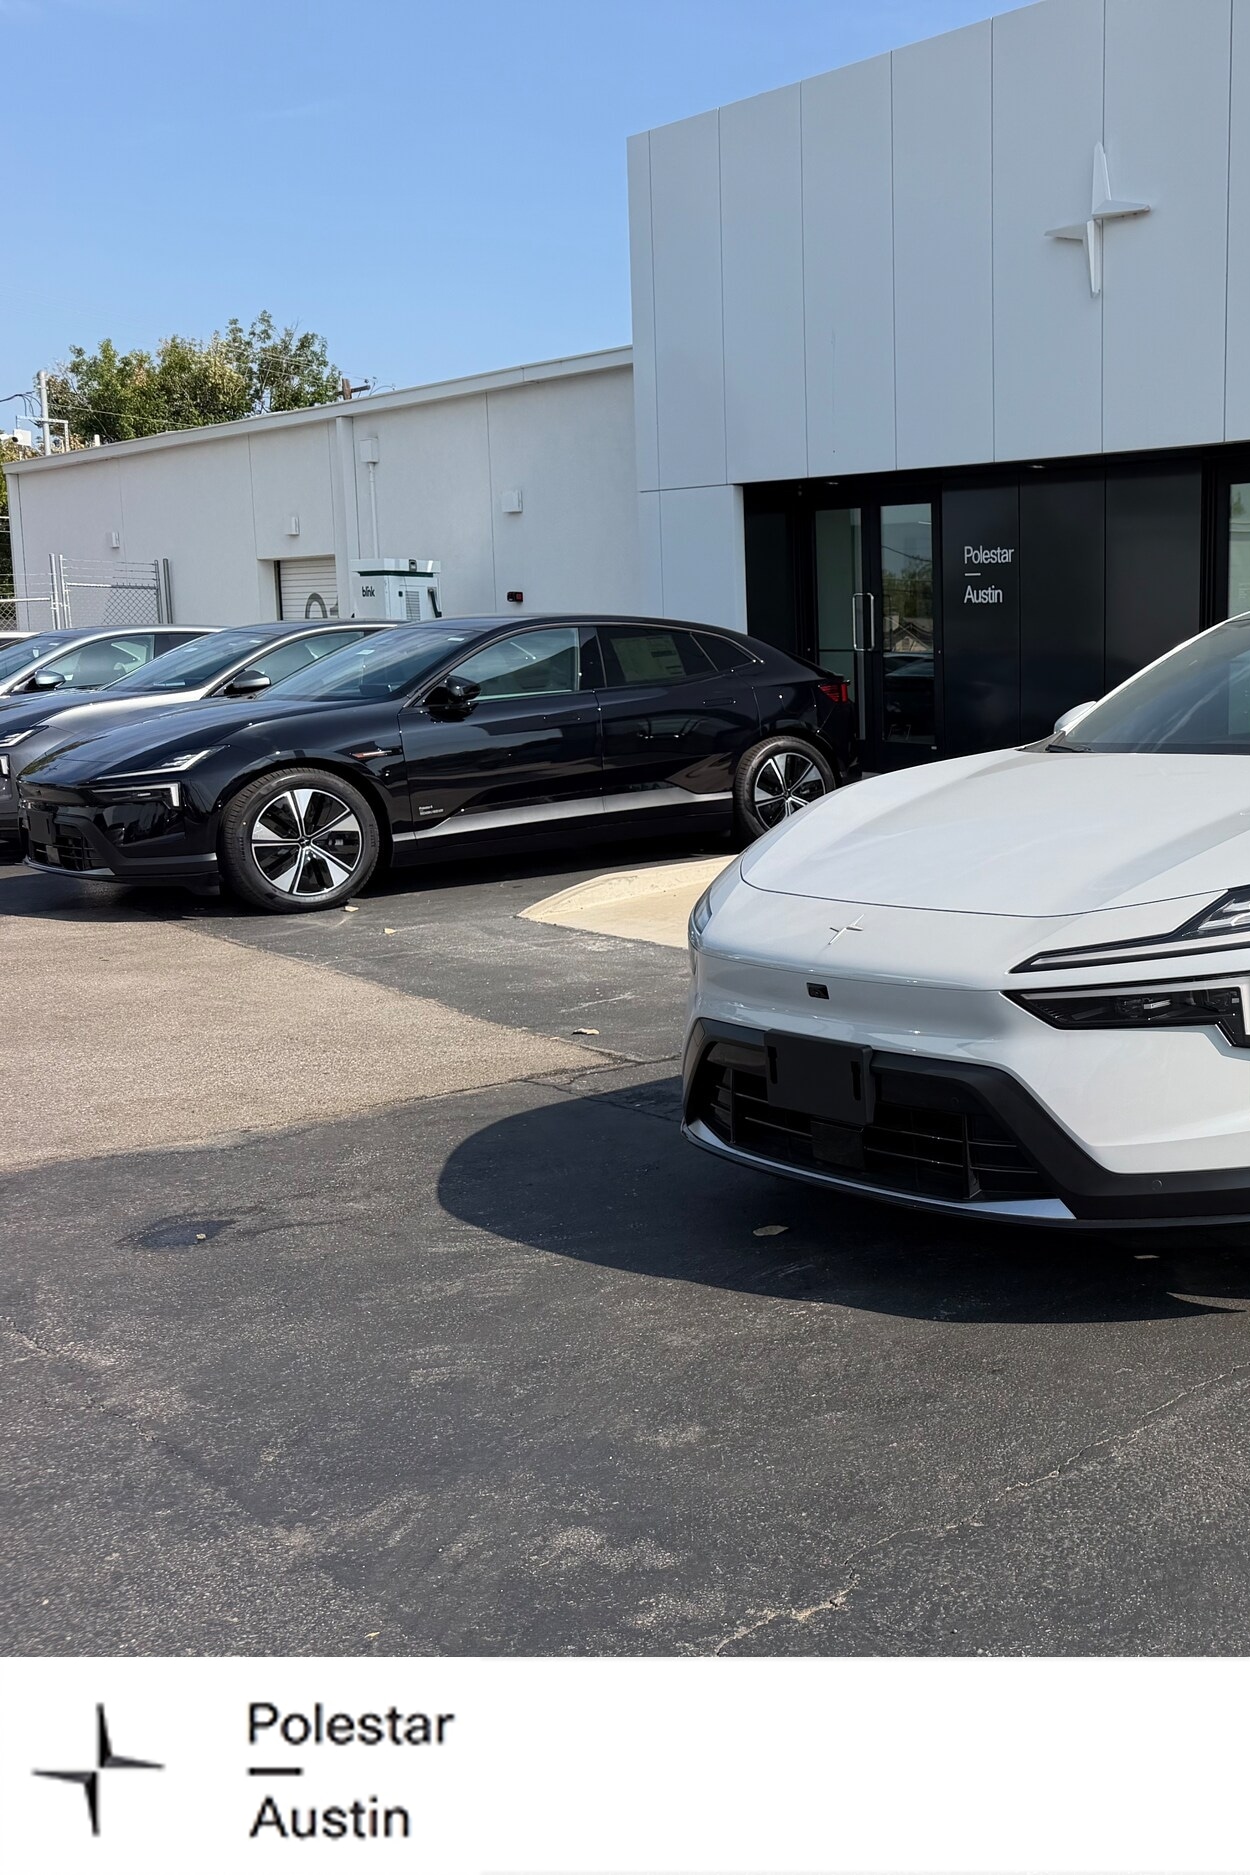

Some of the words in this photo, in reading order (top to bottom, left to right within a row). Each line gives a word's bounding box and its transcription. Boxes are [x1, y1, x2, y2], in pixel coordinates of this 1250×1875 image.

[964, 545, 1015, 564] Polestar
[361, 586, 376, 598] blink
[964, 585, 1003, 603] Austin
